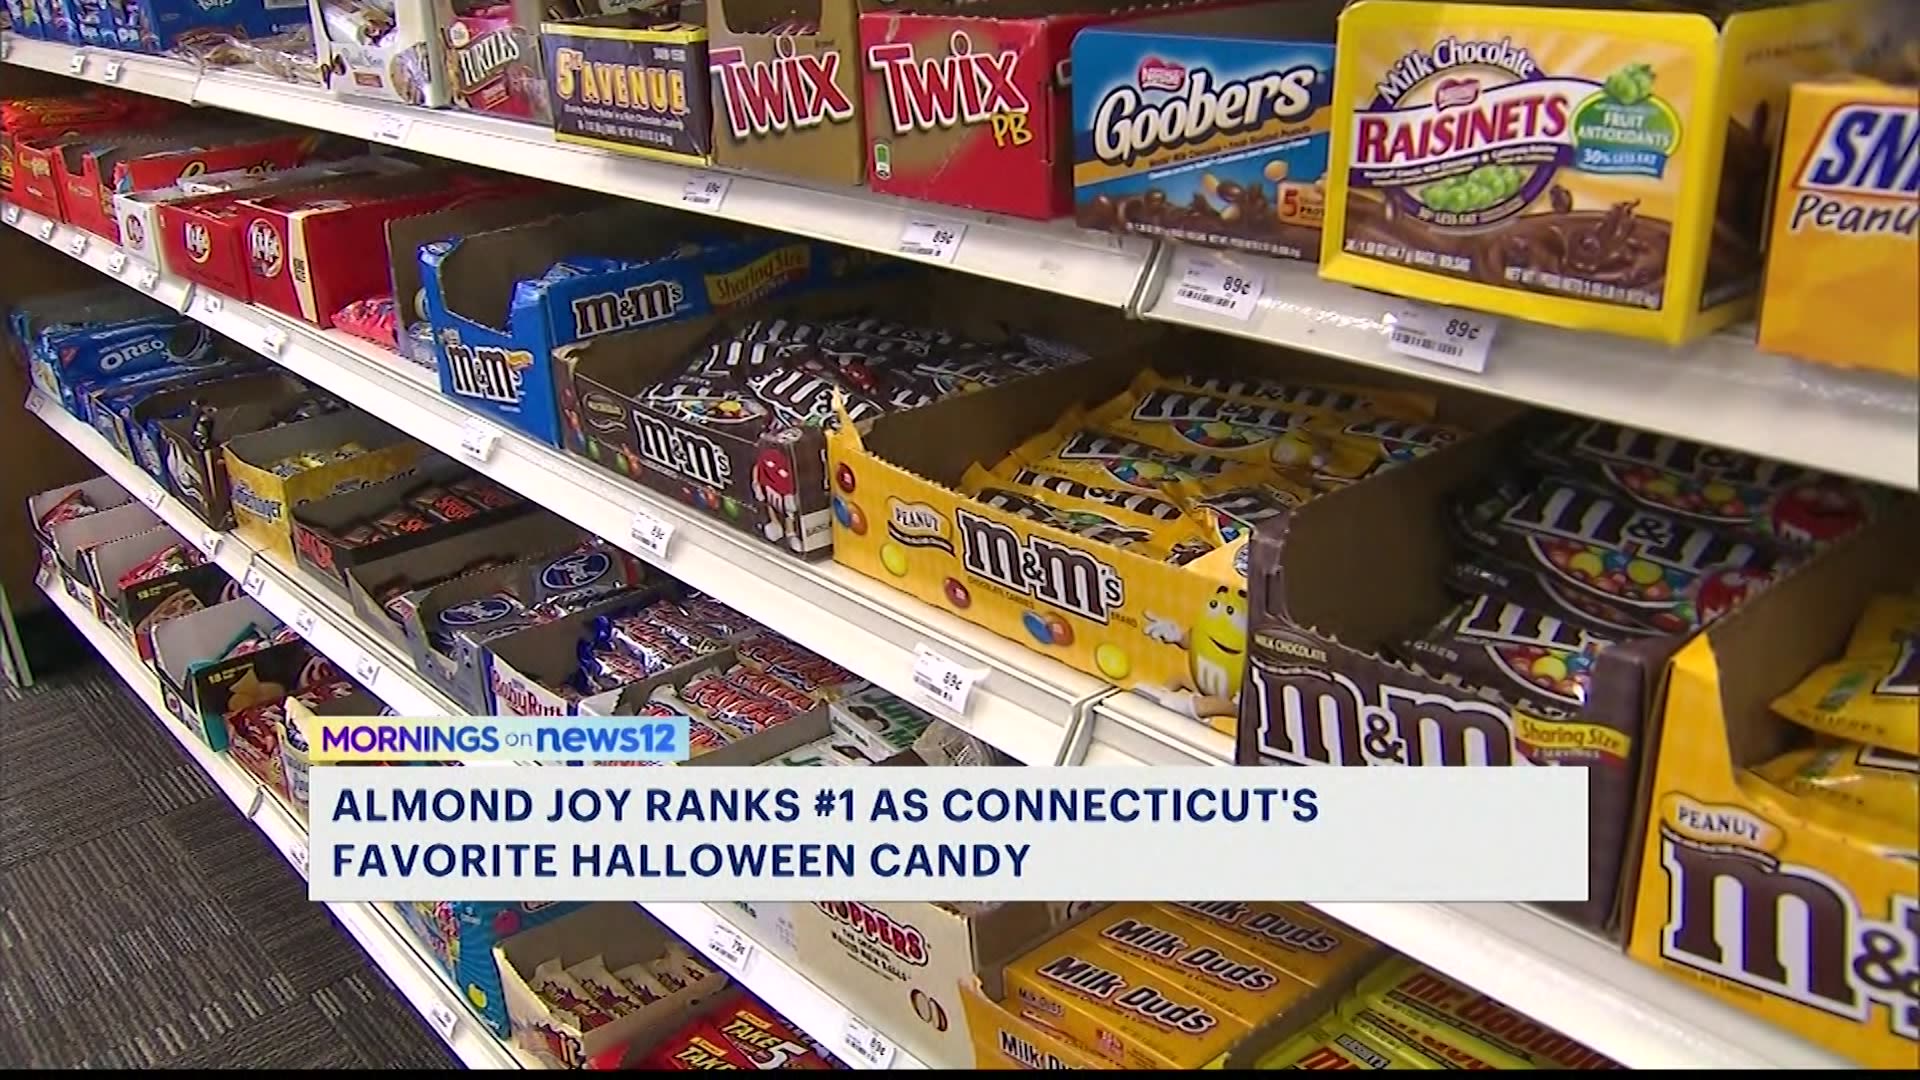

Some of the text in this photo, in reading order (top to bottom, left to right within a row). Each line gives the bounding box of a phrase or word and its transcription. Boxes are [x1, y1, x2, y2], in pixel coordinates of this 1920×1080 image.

[459, 29, 519, 86] TURTLES
[1378, 50, 1435, 105] Milk
[1432, 36, 1536, 79] Chocolate
[581, 61, 688, 116] AVENUE
[1094, 68, 1316, 159] Goobers
[991, 112, 1033, 148] PB
[1357, 94, 1570, 165] RAISINETS
[1603, 111, 1644, 129] FRUIT
[101, 338, 166, 371] OREO
[895, 506, 941, 533] PEANUT
[1254, 633, 1329, 663] MILK CHOCOLATE
[1520, 717, 1621, 748] Sharing Size
[1677, 806, 1760, 841] PEANUT
[1165, 901, 1339, 952] ilk Duds
[1100, 918, 1280, 992] Milk Duds
[1035, 955, 1219, 1035] Milk Duds
[720, 1019, 783, 1050] TAKE
[757, 1041, 809, 1070] 5
[999, 1028, 1046, 1068] Milk
